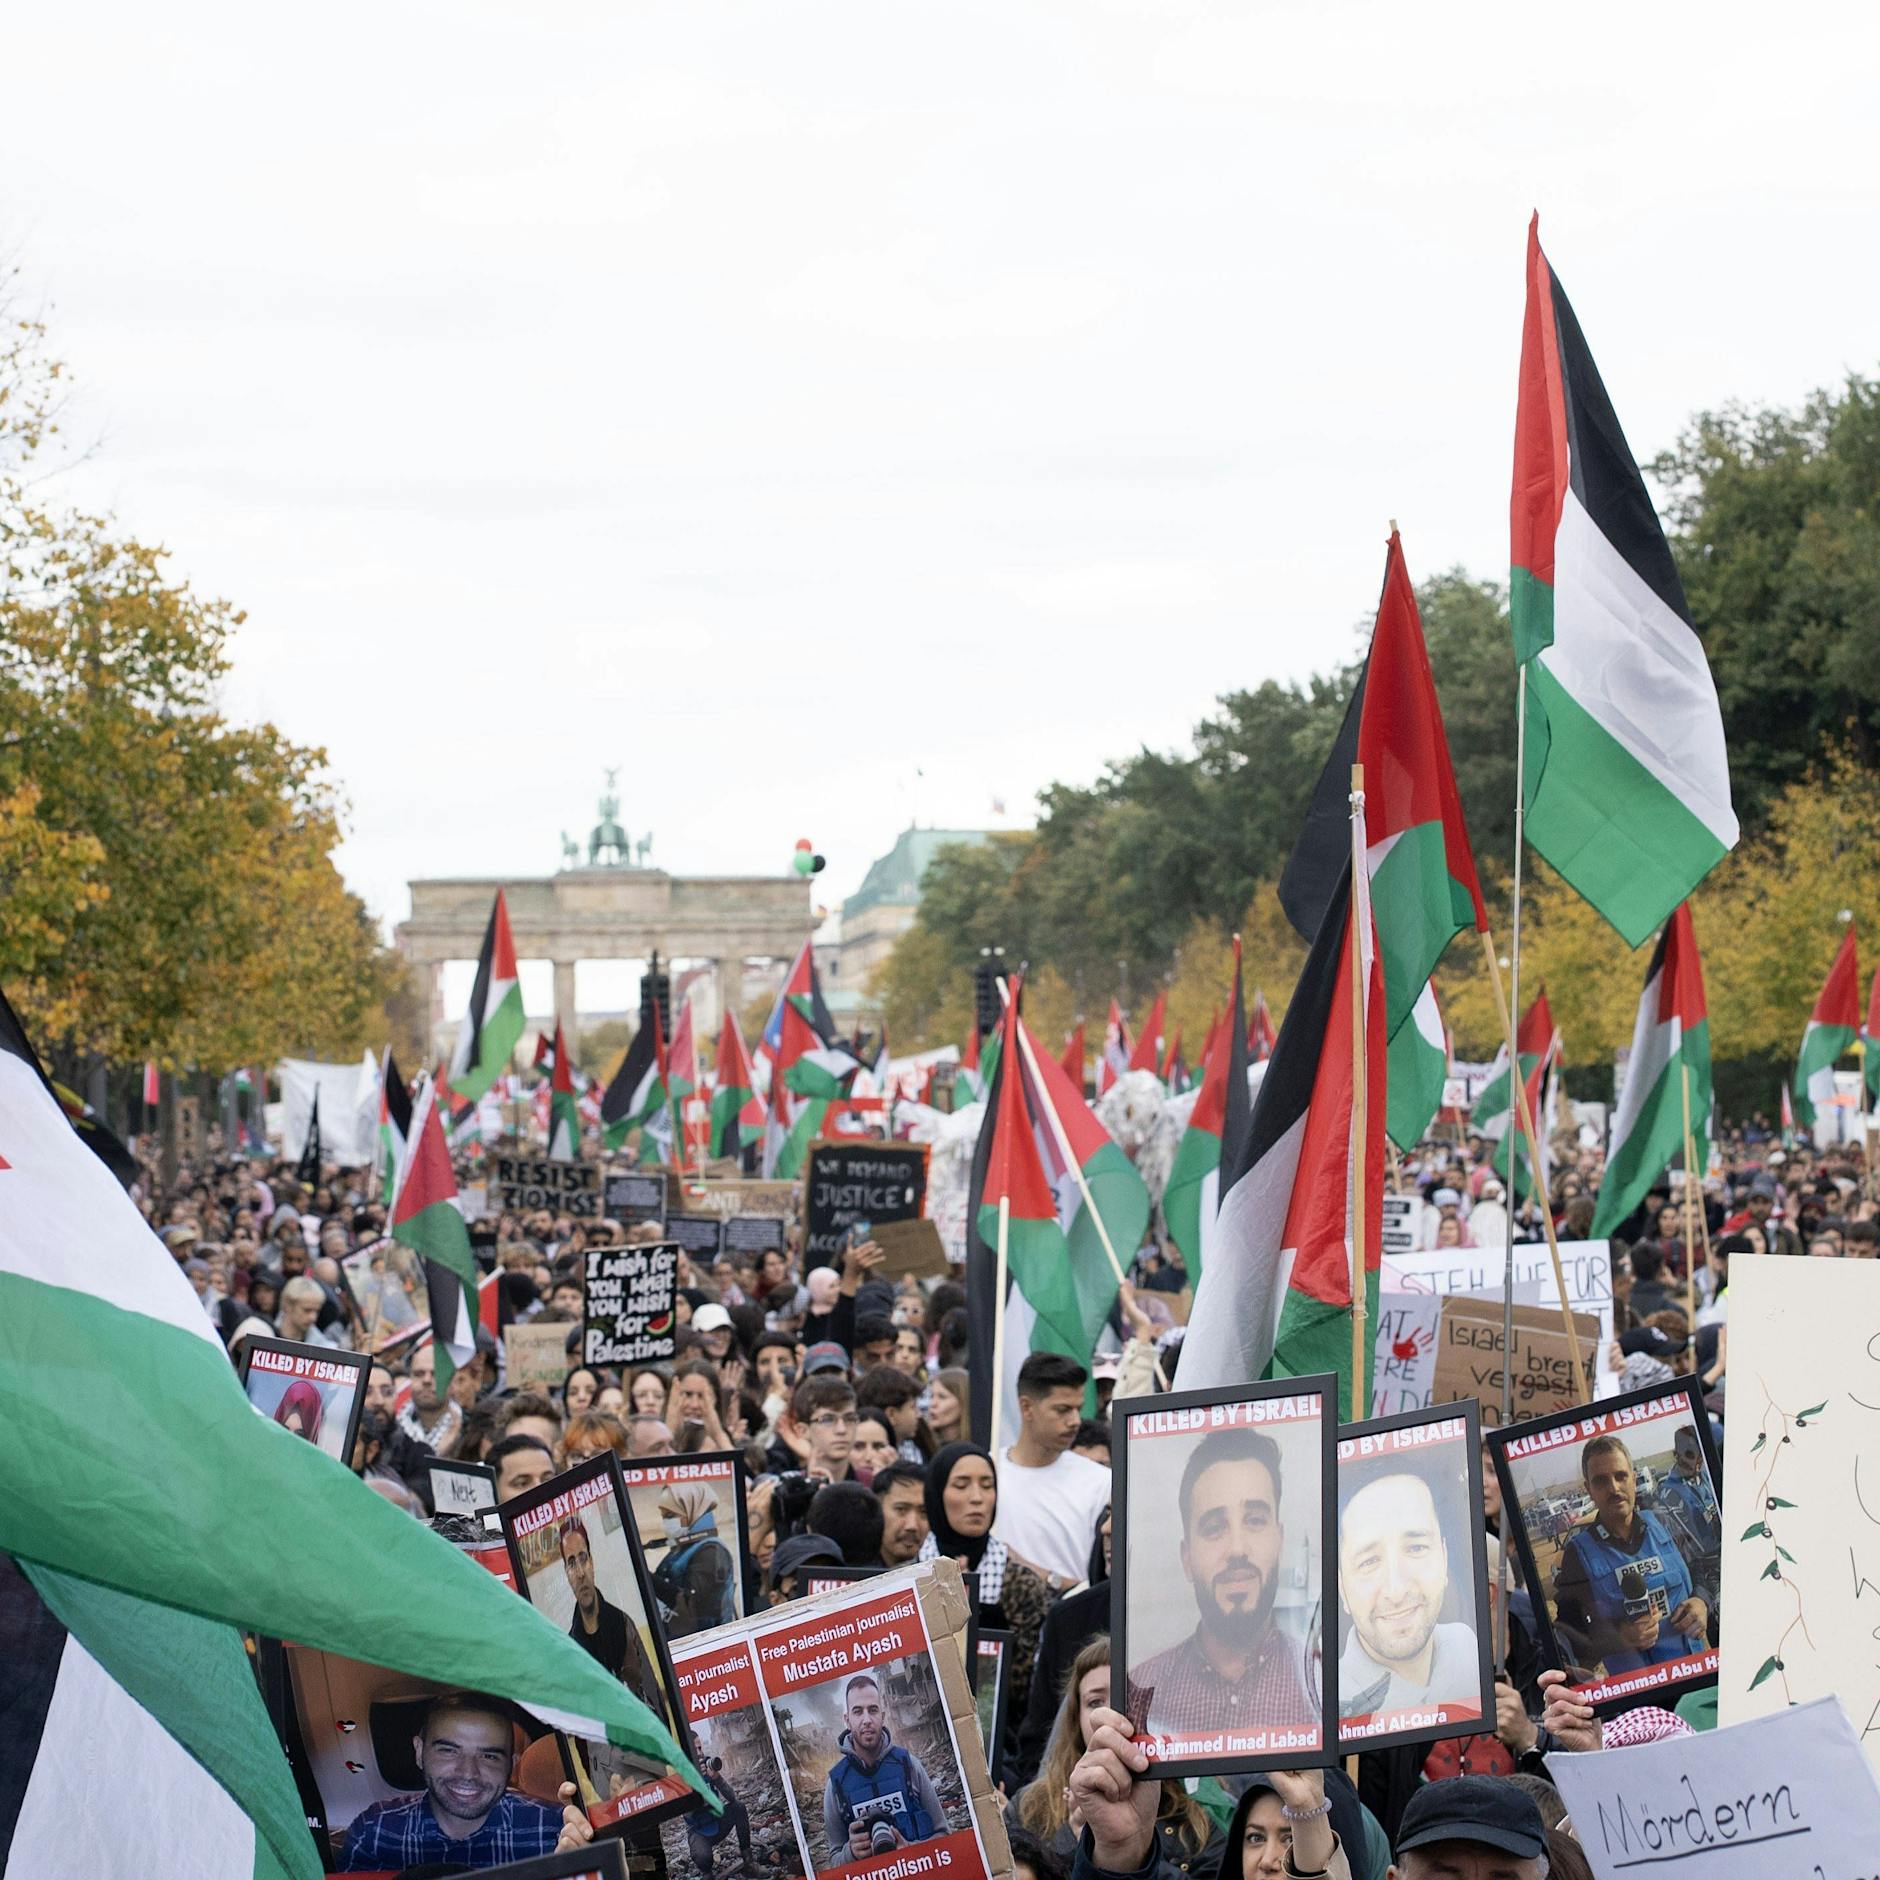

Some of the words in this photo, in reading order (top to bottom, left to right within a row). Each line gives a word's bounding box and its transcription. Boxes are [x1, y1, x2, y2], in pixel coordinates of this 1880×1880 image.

[499, 1158, 594, 1191] RESIST
[815, 1183, 900, 1209] JUSTICE
[586, 1252, 601, 1278] I
[615, 1312, 651, 1338] for
[1449, 1320, 1518, 1353] Israel
[585, 1328, 675, 1364] Palestine
[251, 1350, 294, 1373] KILLED
[294, 1357, 316, 1376] BY
[313, 1361, 358, 1384] ISRAEL
[1132, 1404, 1206, 1436] KILLED
[1211, 1402, 1243, 1425] BY
[1245, 1394, 1322, 1423] ISRAEL
[1506, 1423, 1578, 1458] KILLED
[1581, 1412, 1613, 1437] BY
[1614, 1393, 1687, 1427] ISRAEL
[1361, 1433, 1389, 1455] BY
[1393, 1418, 1465, 1449] ISRAEL
[647, 1466, 671, 1482] BY
[673, 1461, 731, 1479] ISRAEL
[512, 1502, 554, 1538] KILLED
[553, 1494, 571, 1519] BY
[571, 1472, 614, 1511] ISRAEL
[760, 1644, 788, 1662] Free
[788, 1621, 856, 1652] Palestinian
[855, 1601, 916, 1632] journalist
[694, 1654, 750, 1686] journalist
[783, 1649, 849, 1684] Mustafa
[852, 1631, 903, 1664] Ayash
[1671, 1661, 1703, 1680] Abu
[690, 1683, 739, 1714] Ayash
[1388, 1711, 1447, 1732] Al-Qara
[1226, 1733, 1267, 1751] Imad
[1269, 1730, 1317, 1749] Labad
[617, 1801, 632, 1818] Ali
[1597, 1774, 1800, 1854] Mördern
[934, 1848, 952, 1867] is
